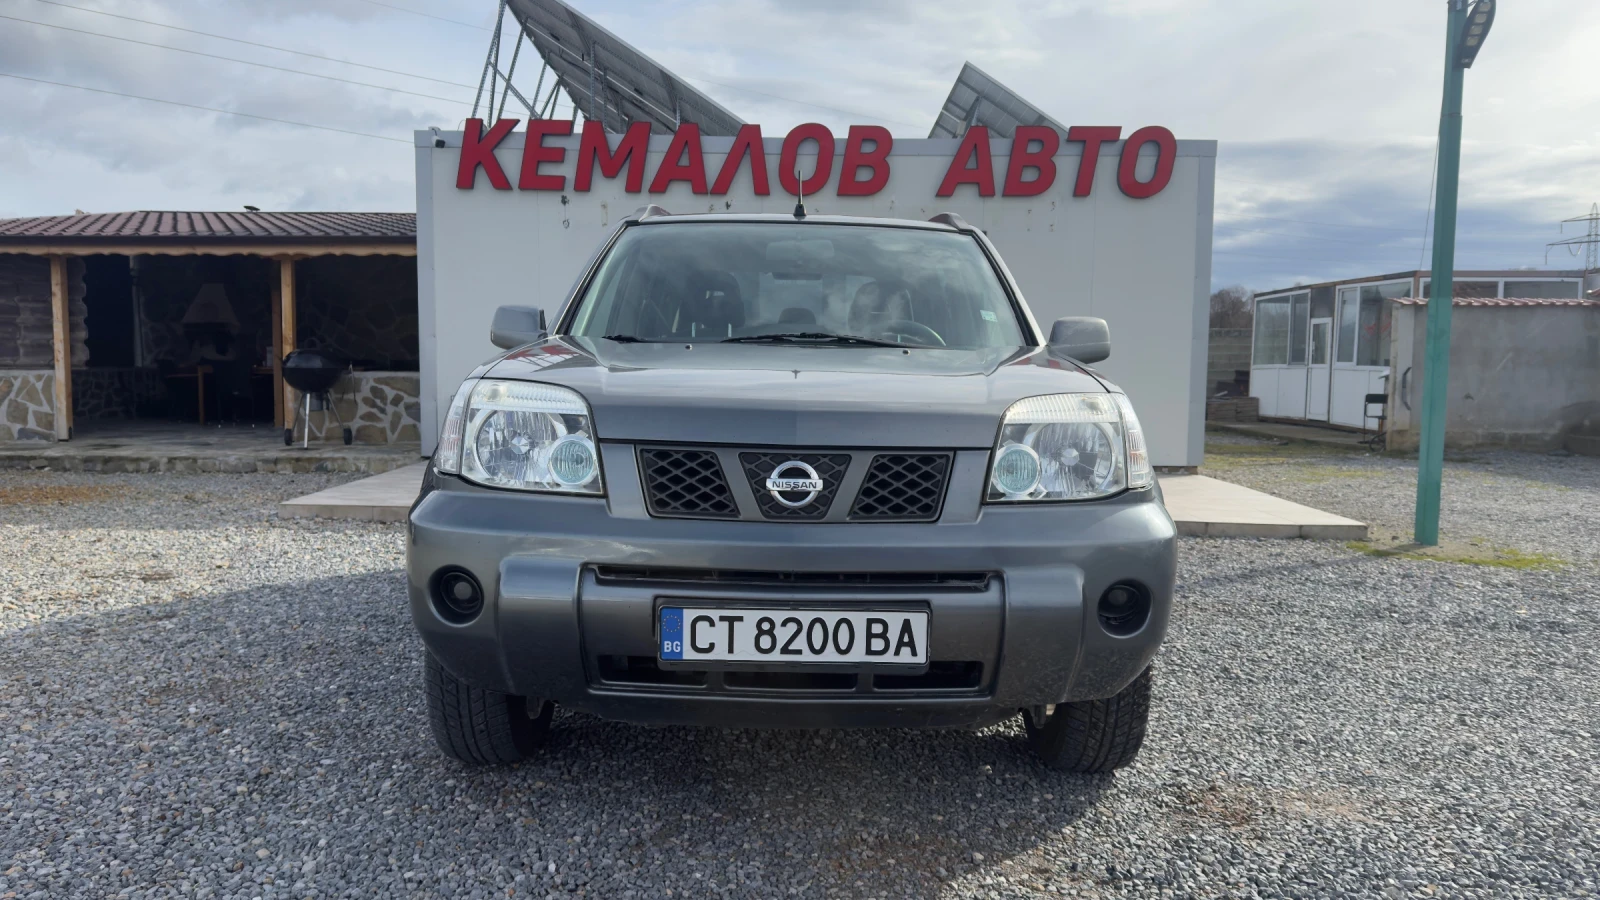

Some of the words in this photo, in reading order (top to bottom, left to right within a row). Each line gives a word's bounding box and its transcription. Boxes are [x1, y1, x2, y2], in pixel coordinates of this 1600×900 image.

[456, 117, 893, 197] КЕМАЛОВ
[936, 125, 1177, 199] АВТО
[772, 480, 817, 490] NISSAN
[663, 640, 681, 653] BG
[690, 615, 744, 655] CT
[754, 617, 855, 656] 8200
[865, 618, 918, 657] BA
